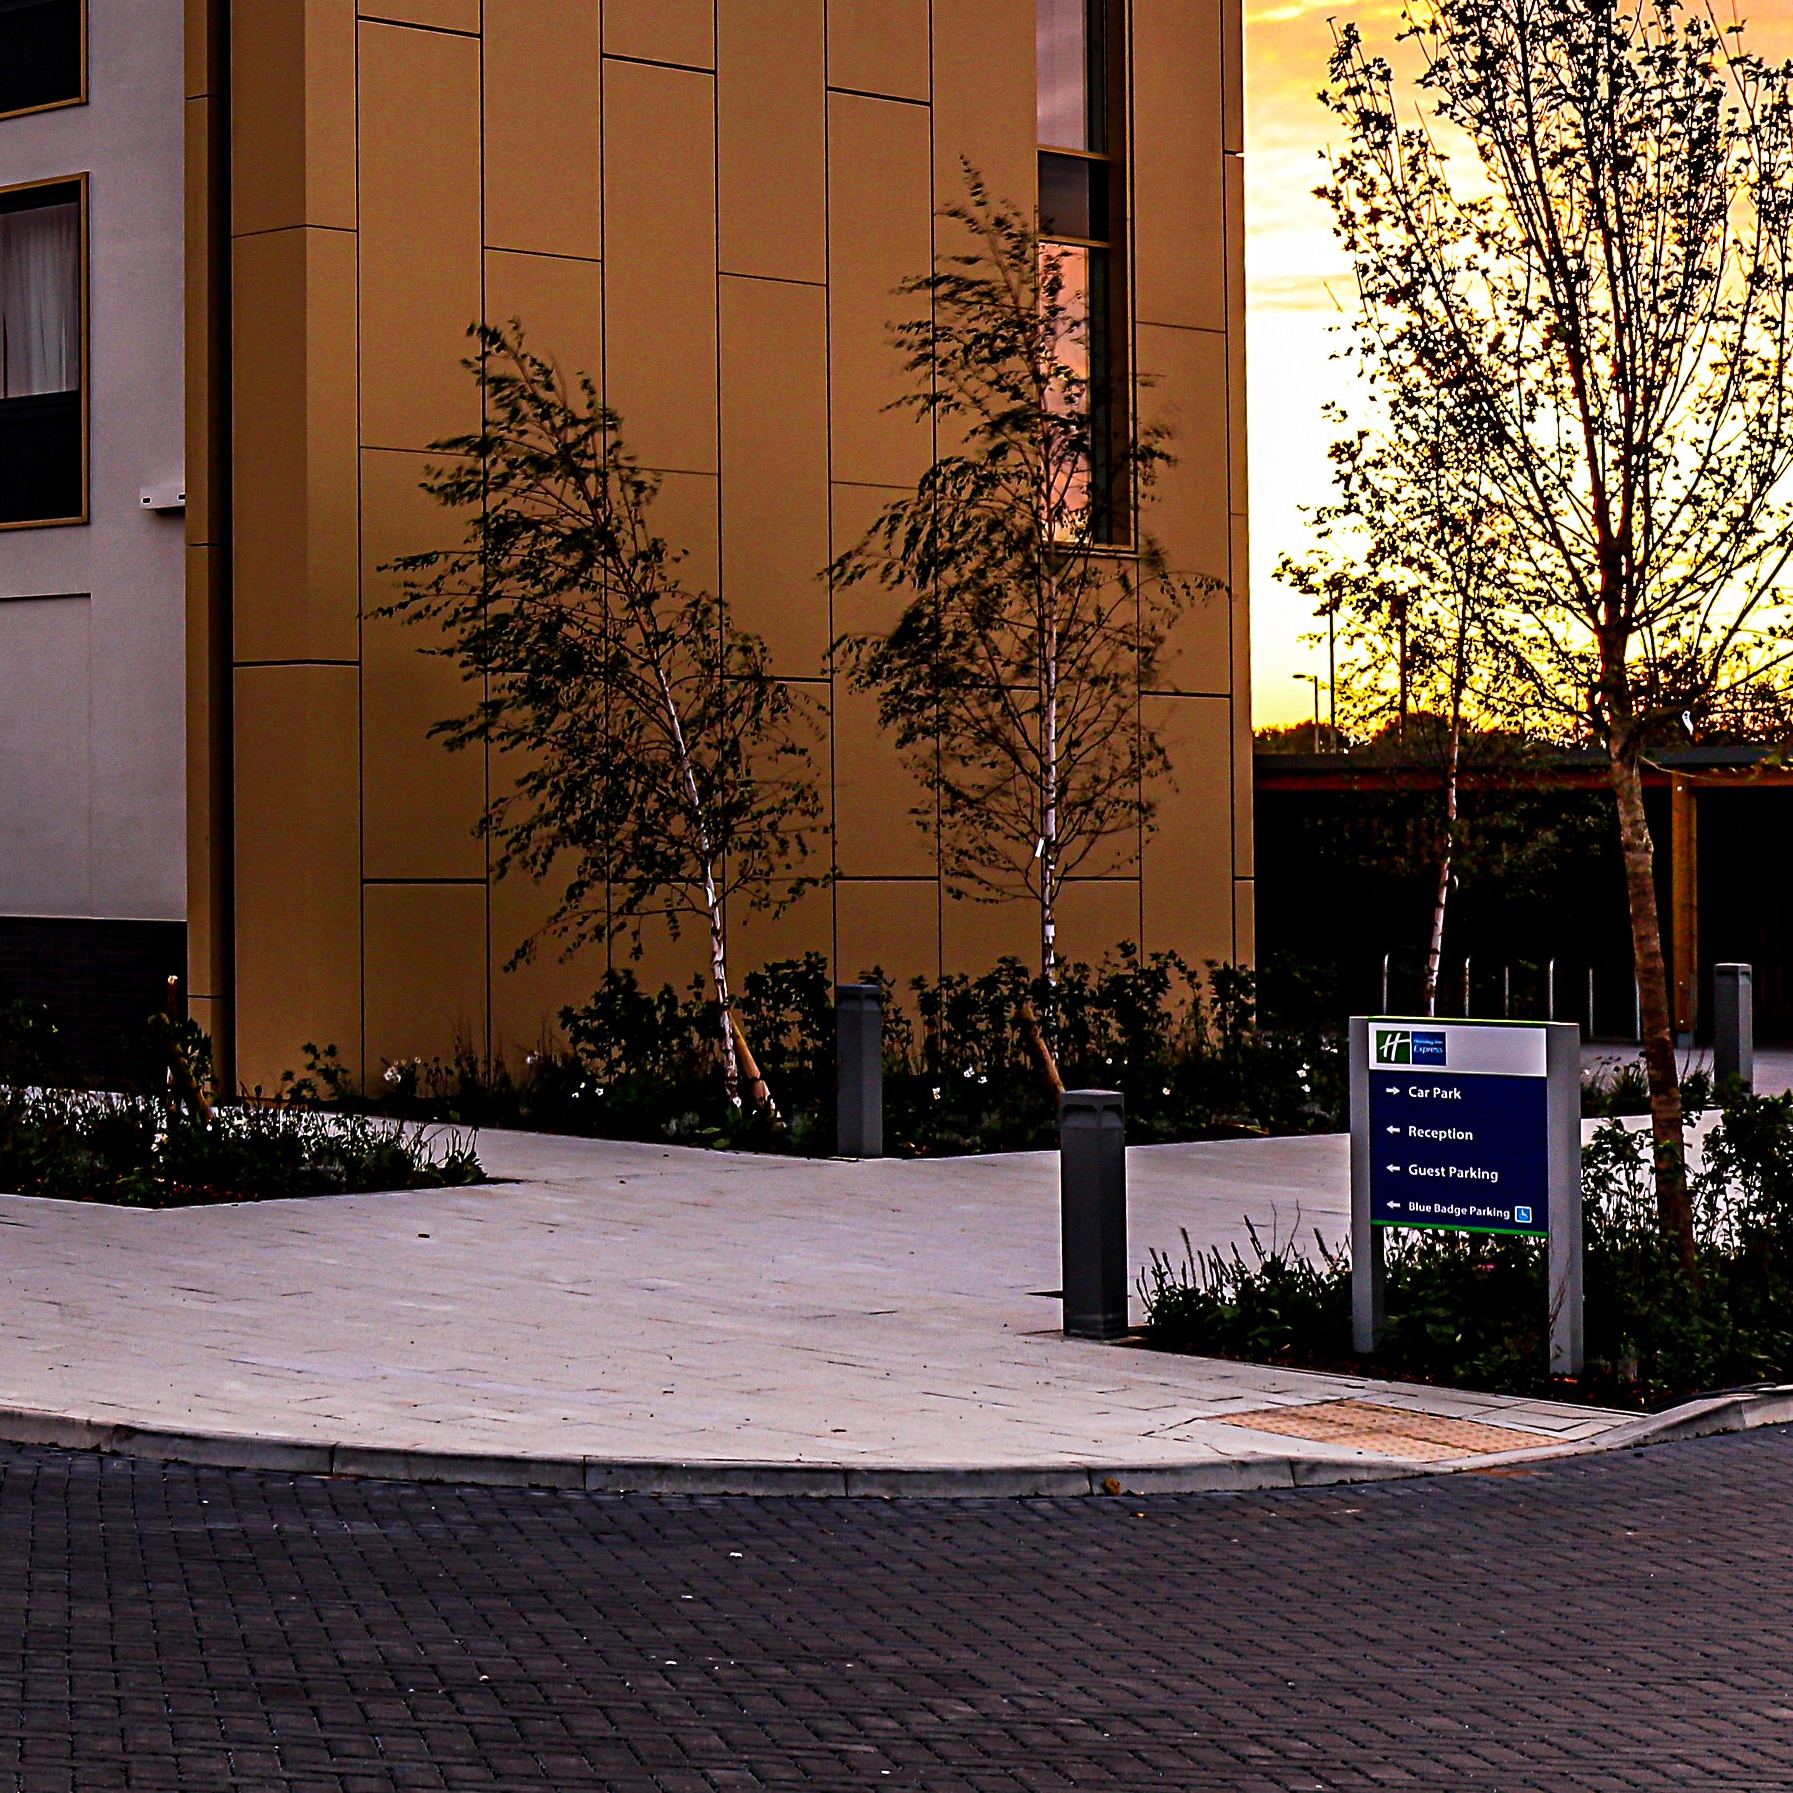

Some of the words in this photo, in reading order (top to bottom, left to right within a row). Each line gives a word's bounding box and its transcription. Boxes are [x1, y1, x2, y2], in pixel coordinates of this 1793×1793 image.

[1413, 1044, 1444, 1055] Express
[1408, 1085, 1430, 1098] Car
[1433, 1087, 1462, 1100] Park
[1408, 1125, 1474, 1142] Reception
[1408, 1163, 1446, 1177] Guest
[1449, 1166, 1499, 1183] Parking
[1408, 1201, 1432, 1213] Blue
[1434, 1203, 1468, 1217] Badge
[1469, 1206, 1511, 1220] Parking
